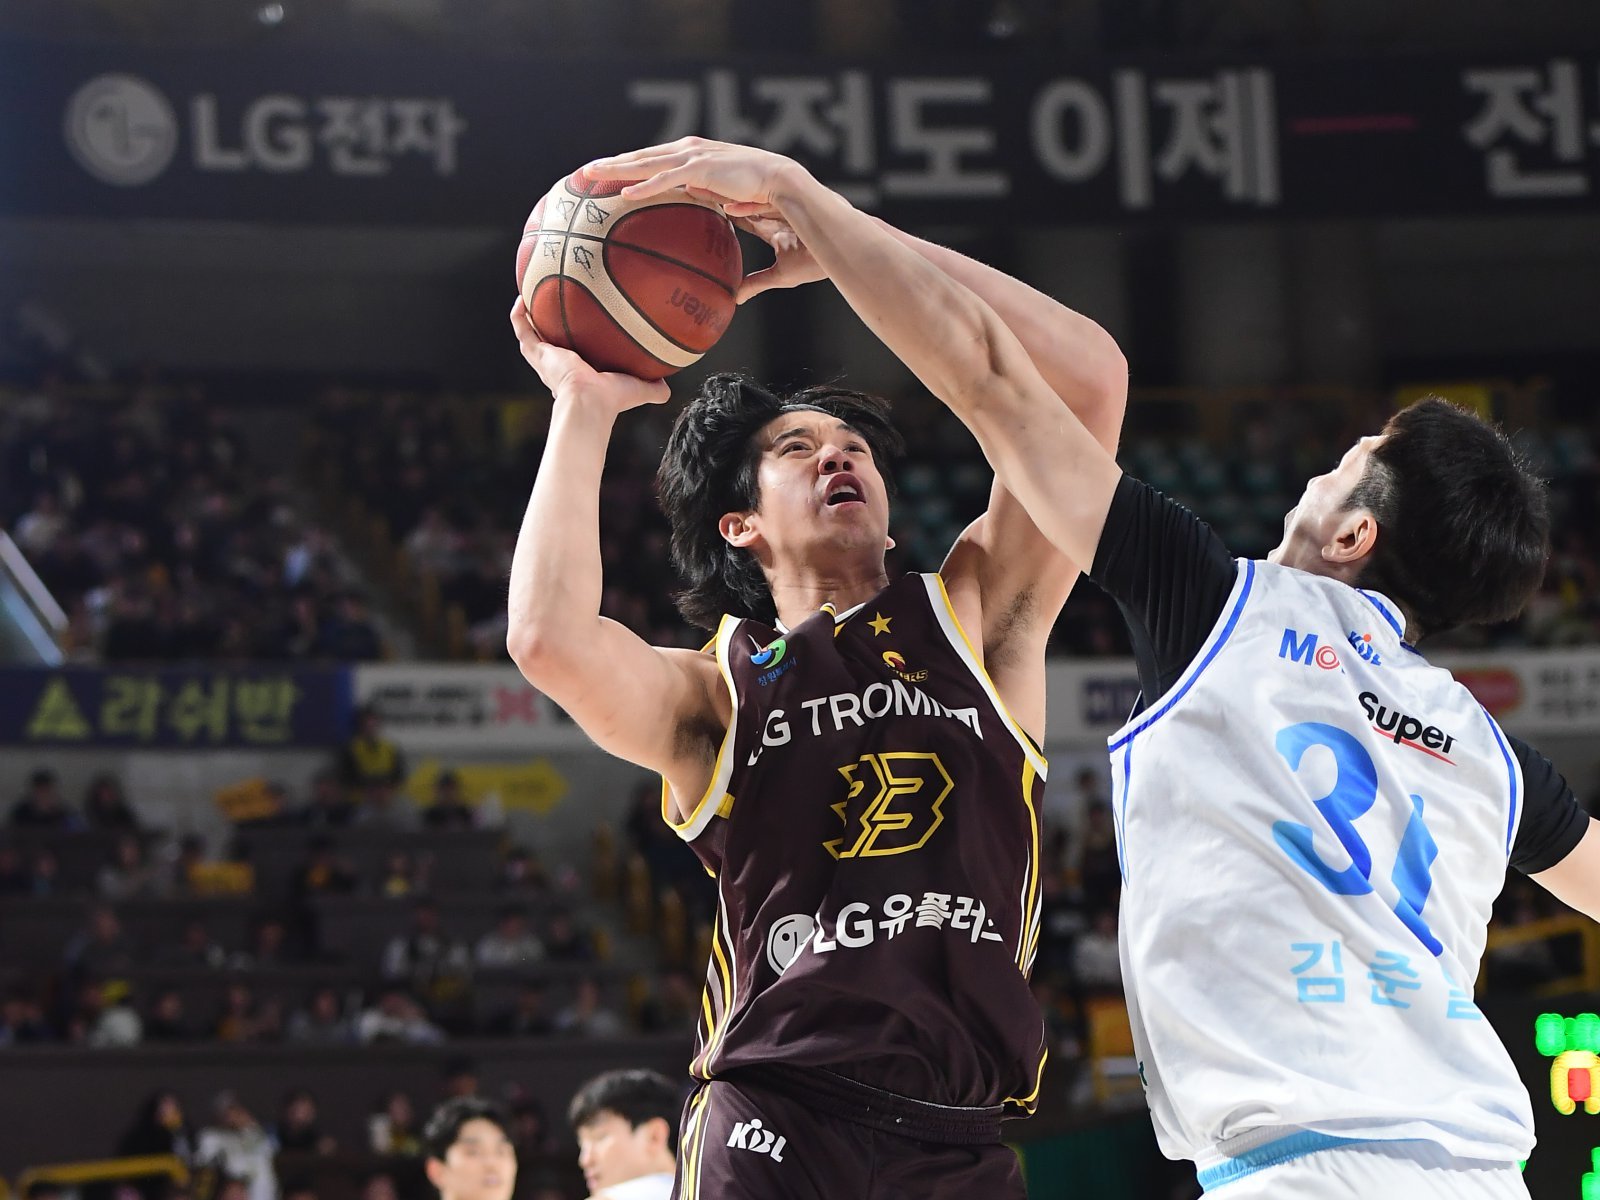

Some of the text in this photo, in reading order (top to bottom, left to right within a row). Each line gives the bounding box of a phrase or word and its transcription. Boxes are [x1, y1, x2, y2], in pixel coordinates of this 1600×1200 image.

[1030, 68, 1281, 208] 이제
[1461, 61, 1600, 196] 전
[747, 708, 792, 767] G
[1358, 690, 1458, 756] Super
